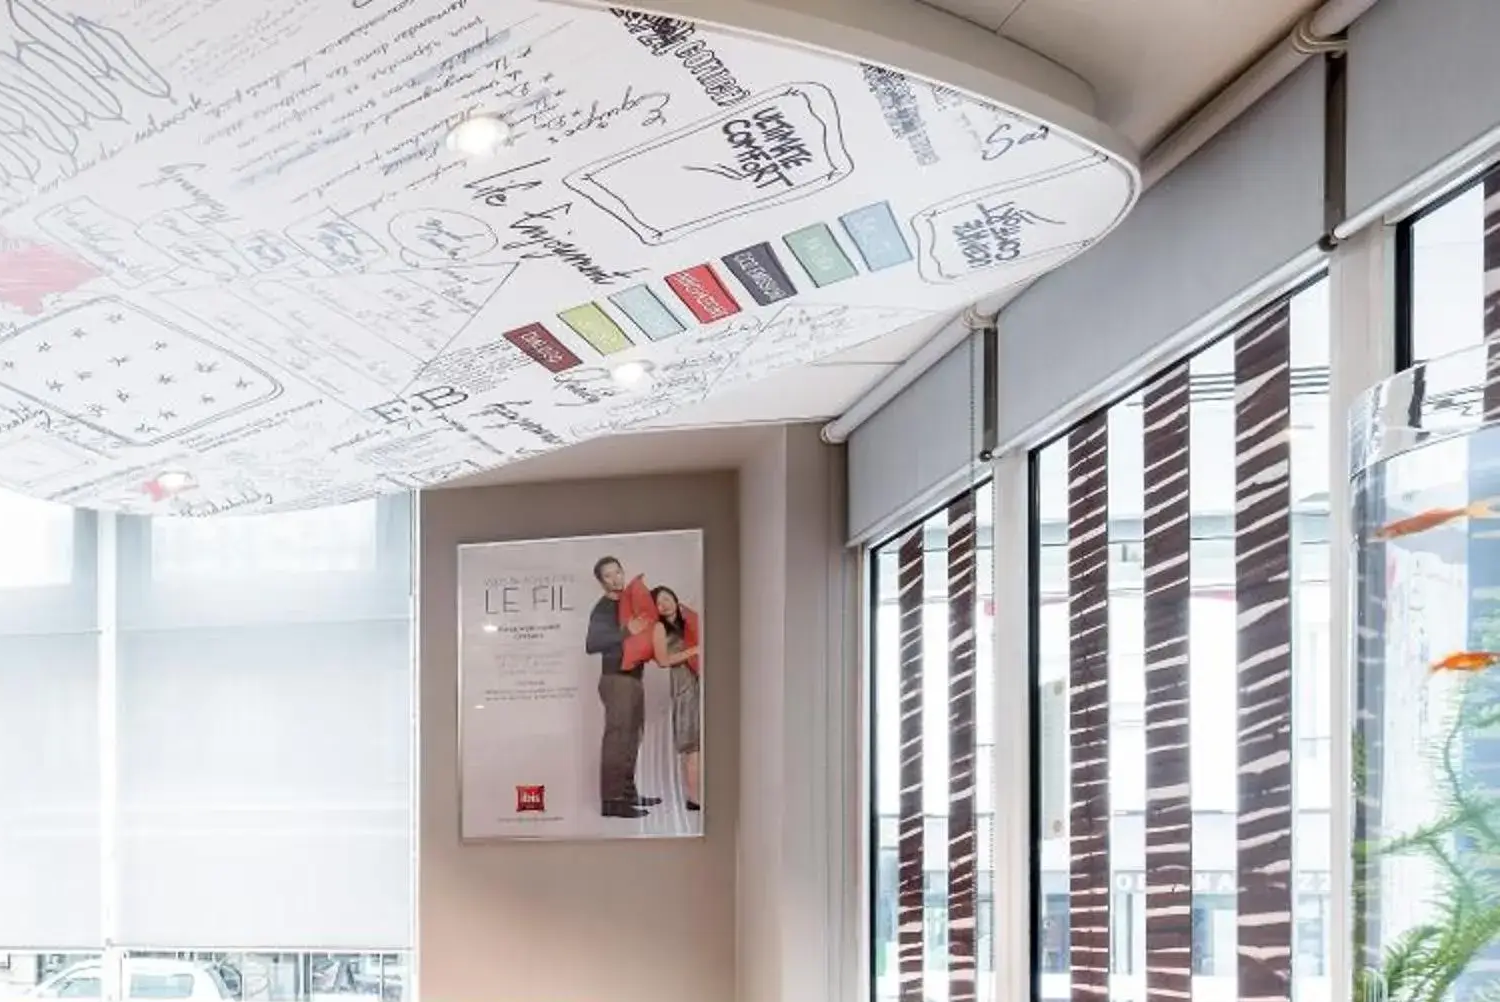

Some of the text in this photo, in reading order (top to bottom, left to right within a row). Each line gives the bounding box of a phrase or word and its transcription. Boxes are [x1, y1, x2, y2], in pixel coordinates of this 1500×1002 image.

[722, 118, 794, 189] COMFORT
[485, 584, 575, 615] LE FIL
